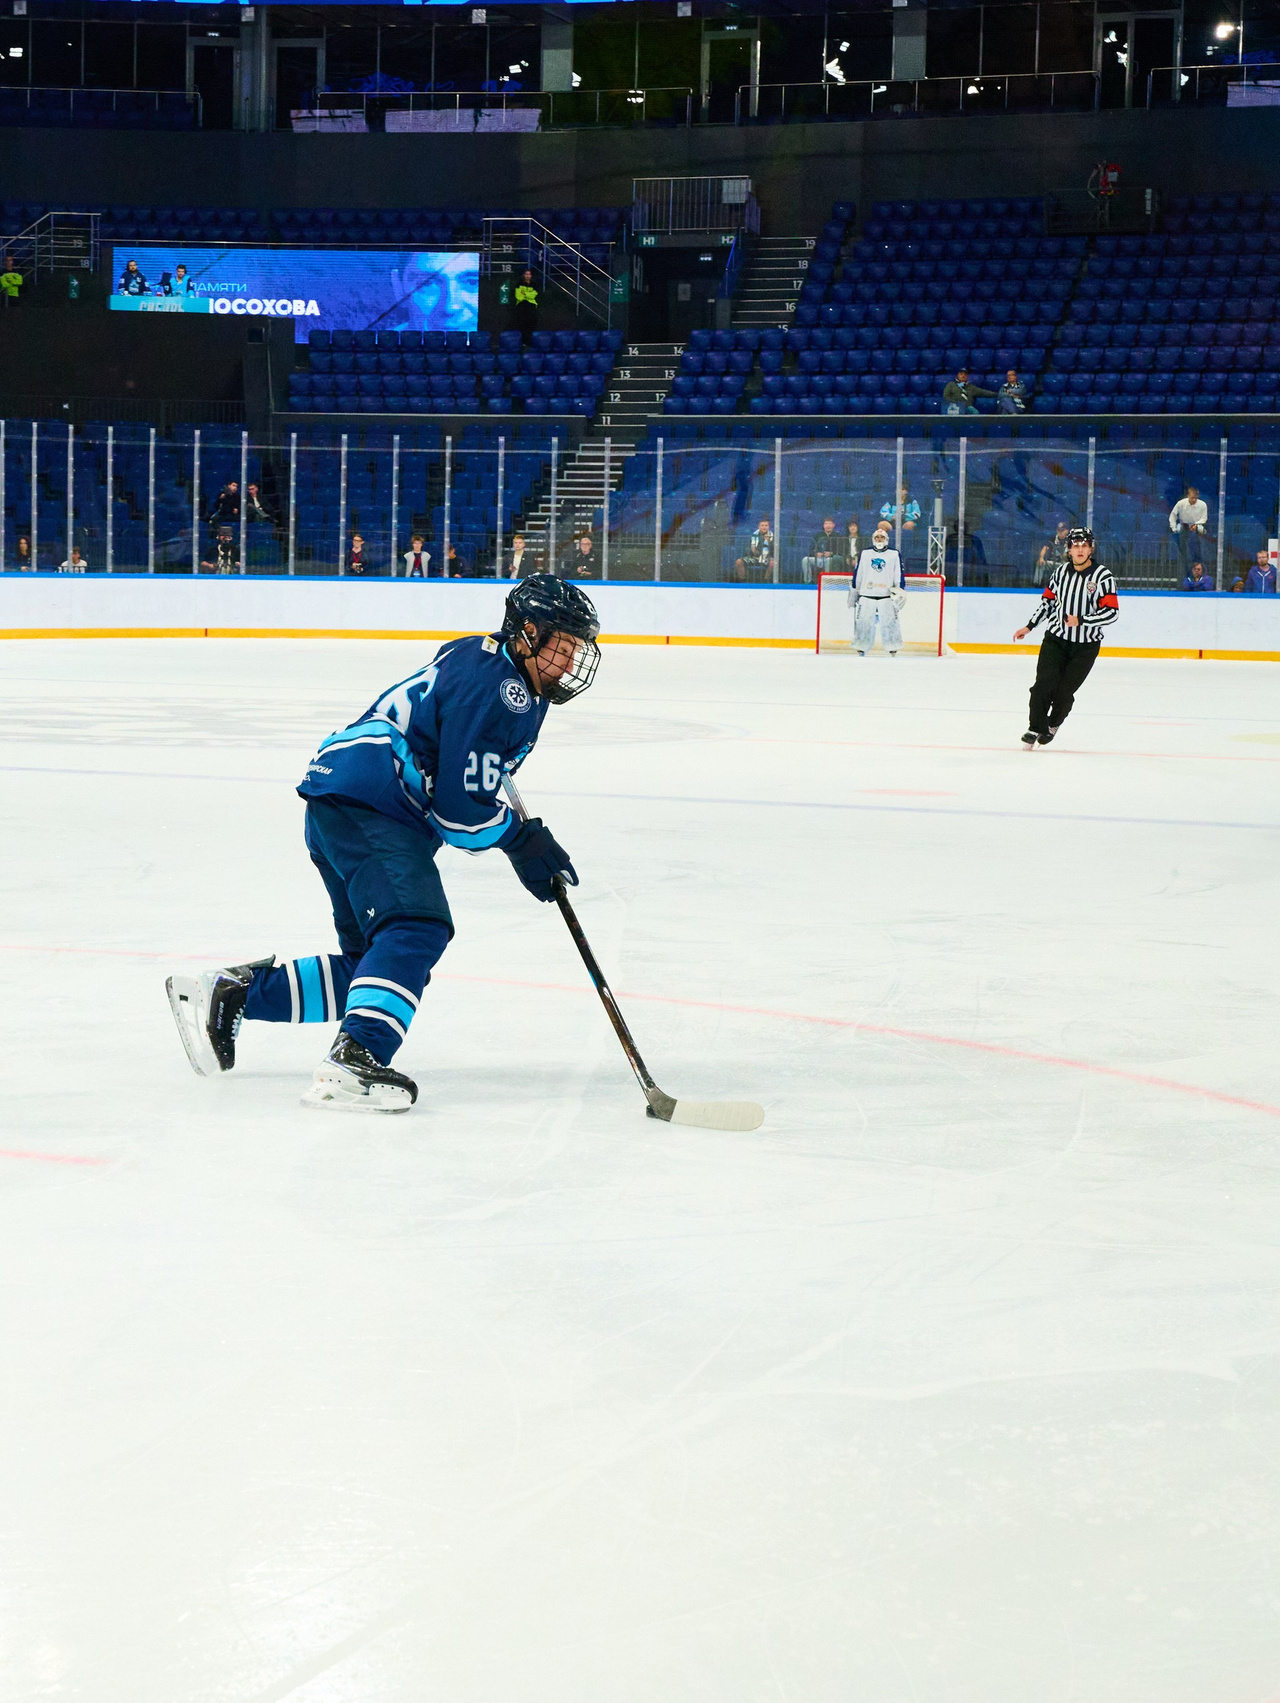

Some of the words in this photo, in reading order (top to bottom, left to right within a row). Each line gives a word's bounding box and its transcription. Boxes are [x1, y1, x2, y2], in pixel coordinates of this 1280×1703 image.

[643, 236, 655, 246] H1
[722, 235, 735, 244] H2
[805, 239, 816, 248] 19
[501, 264, 512, 272] 18
[798, 260, 808, 269] 18
[793, 280, 803, 290] 17
[785, 302, 796, 311] 16
[628, 346, 639, 355] 14
[673, 346, 684, 355] 14
[620, 370, 631, 379] 13
[664, 370, 675, 379] 13
[609, 393, 621, 402] 12
[655, 393, 666, 402] 12
[602, 416, 611, 425] 11
[463, 751, 501, 792] 26
